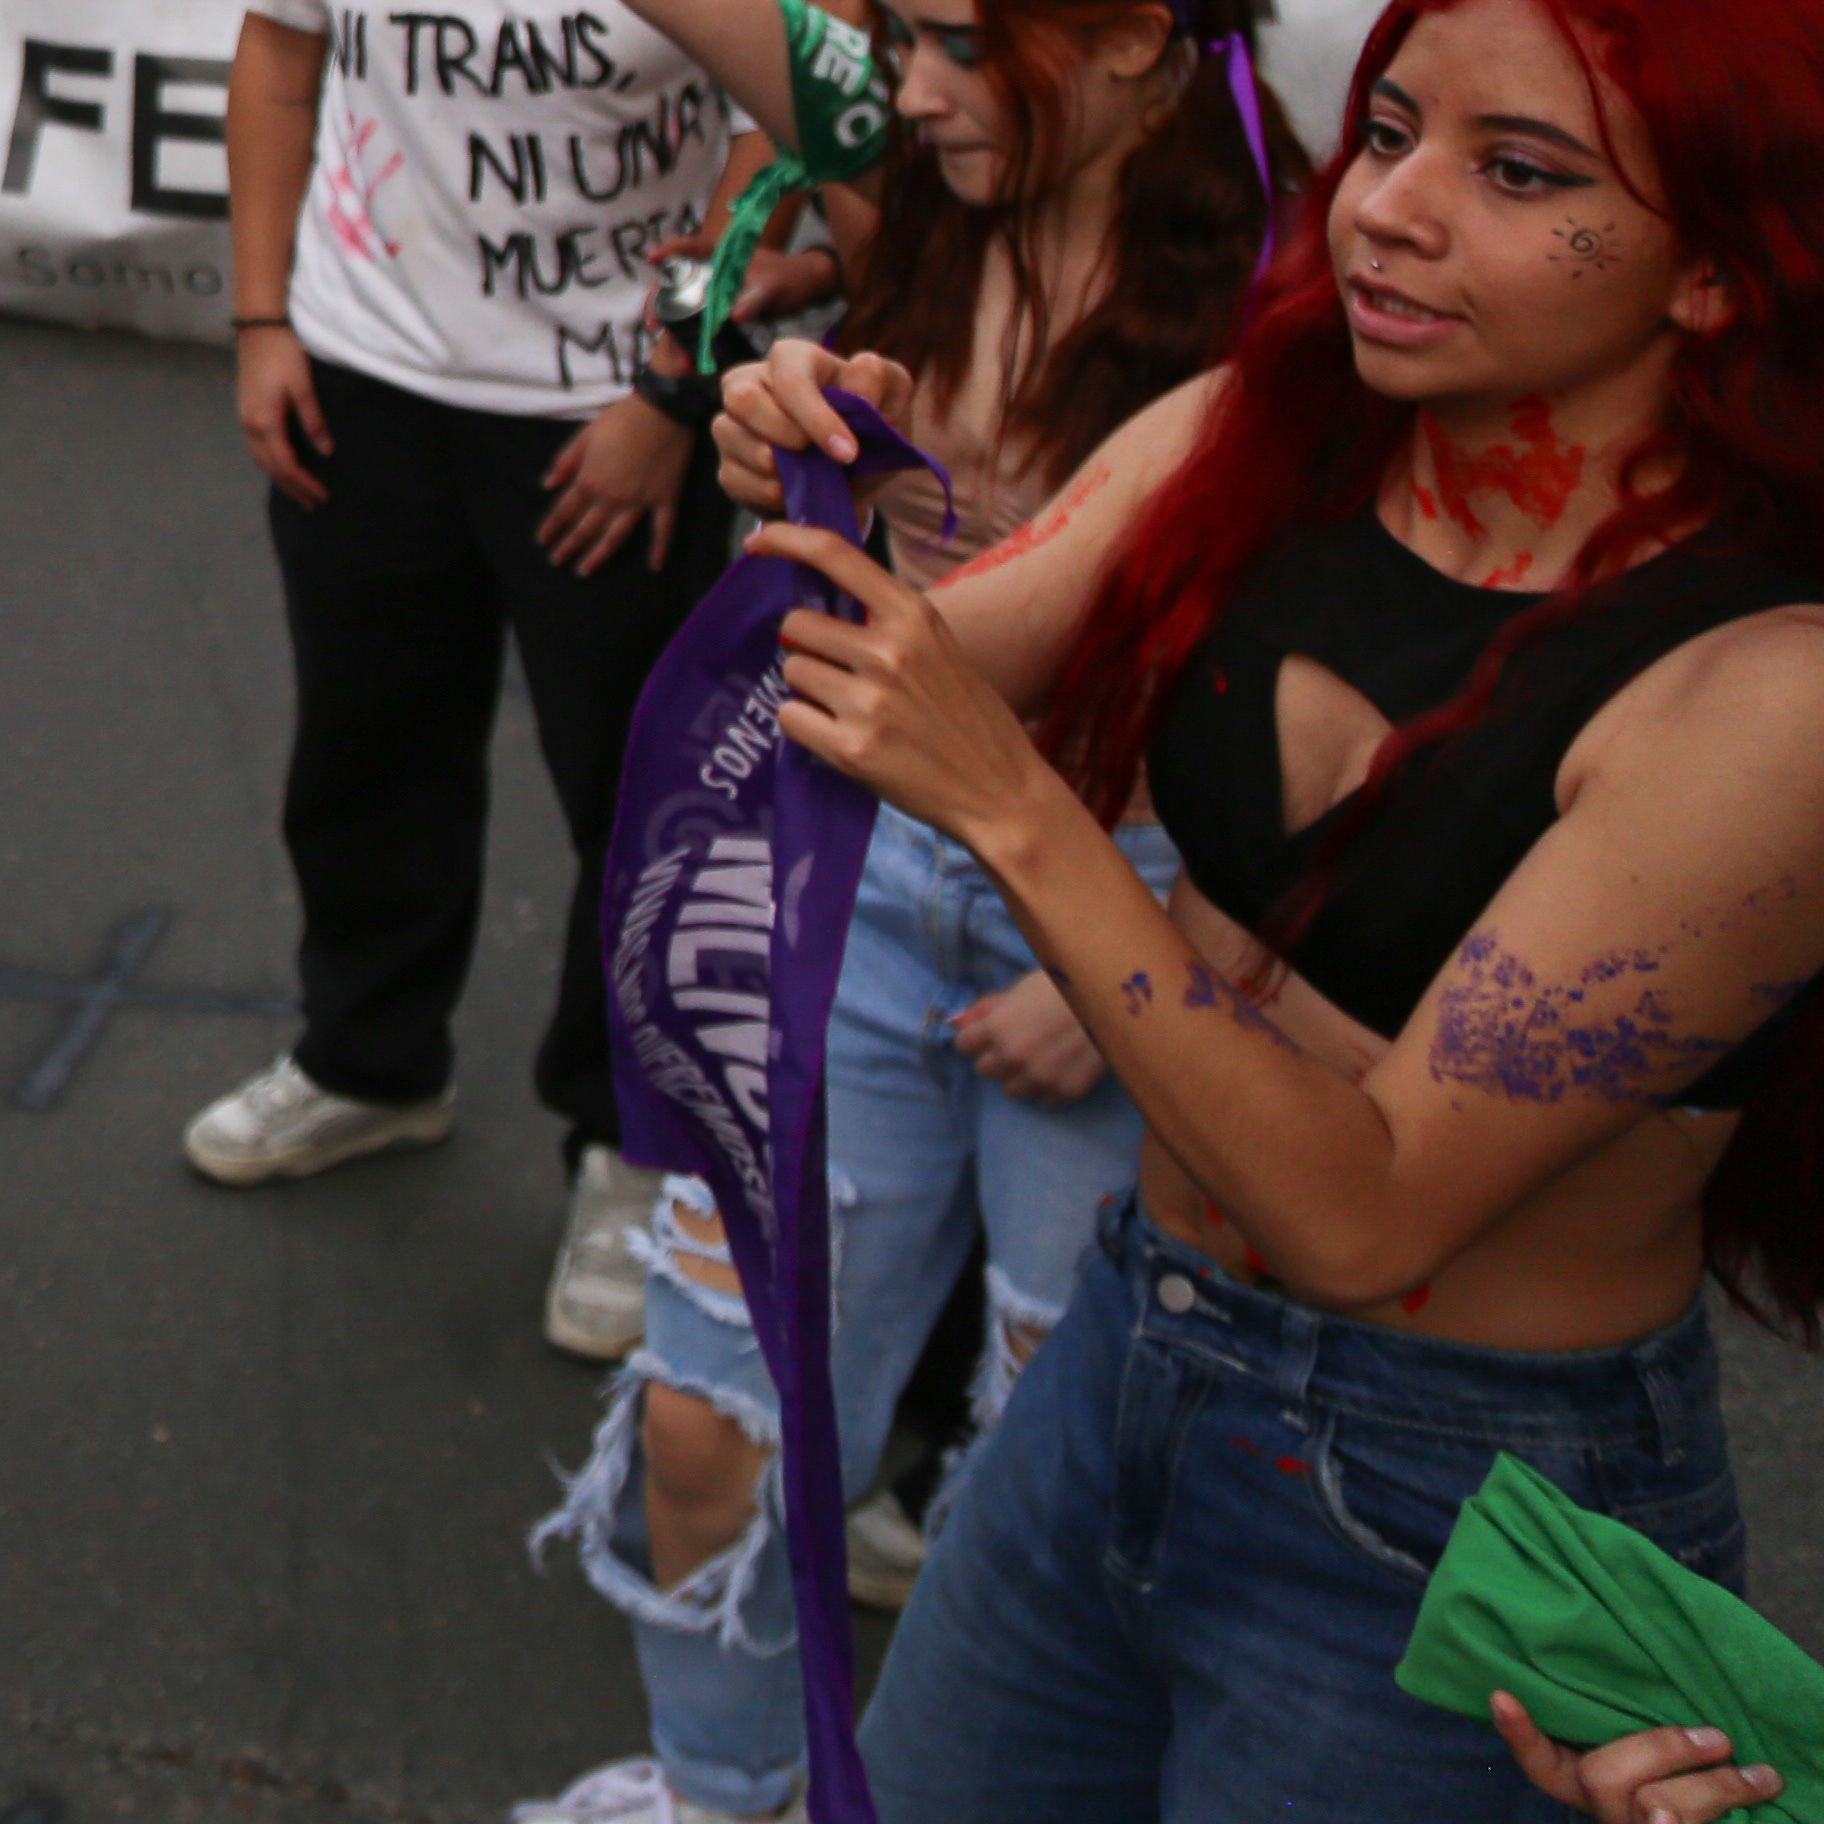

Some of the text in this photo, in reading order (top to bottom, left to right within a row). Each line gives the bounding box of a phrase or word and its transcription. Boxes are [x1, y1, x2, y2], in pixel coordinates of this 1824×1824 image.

[389, 12, 637, 96] TRANS,
[1, 38, 231, 218] FE
[467, 82, 710, 205] NI UNA
[17, 245, 225, 295] Somo
[476, 208, 705, 300] MUERTA
